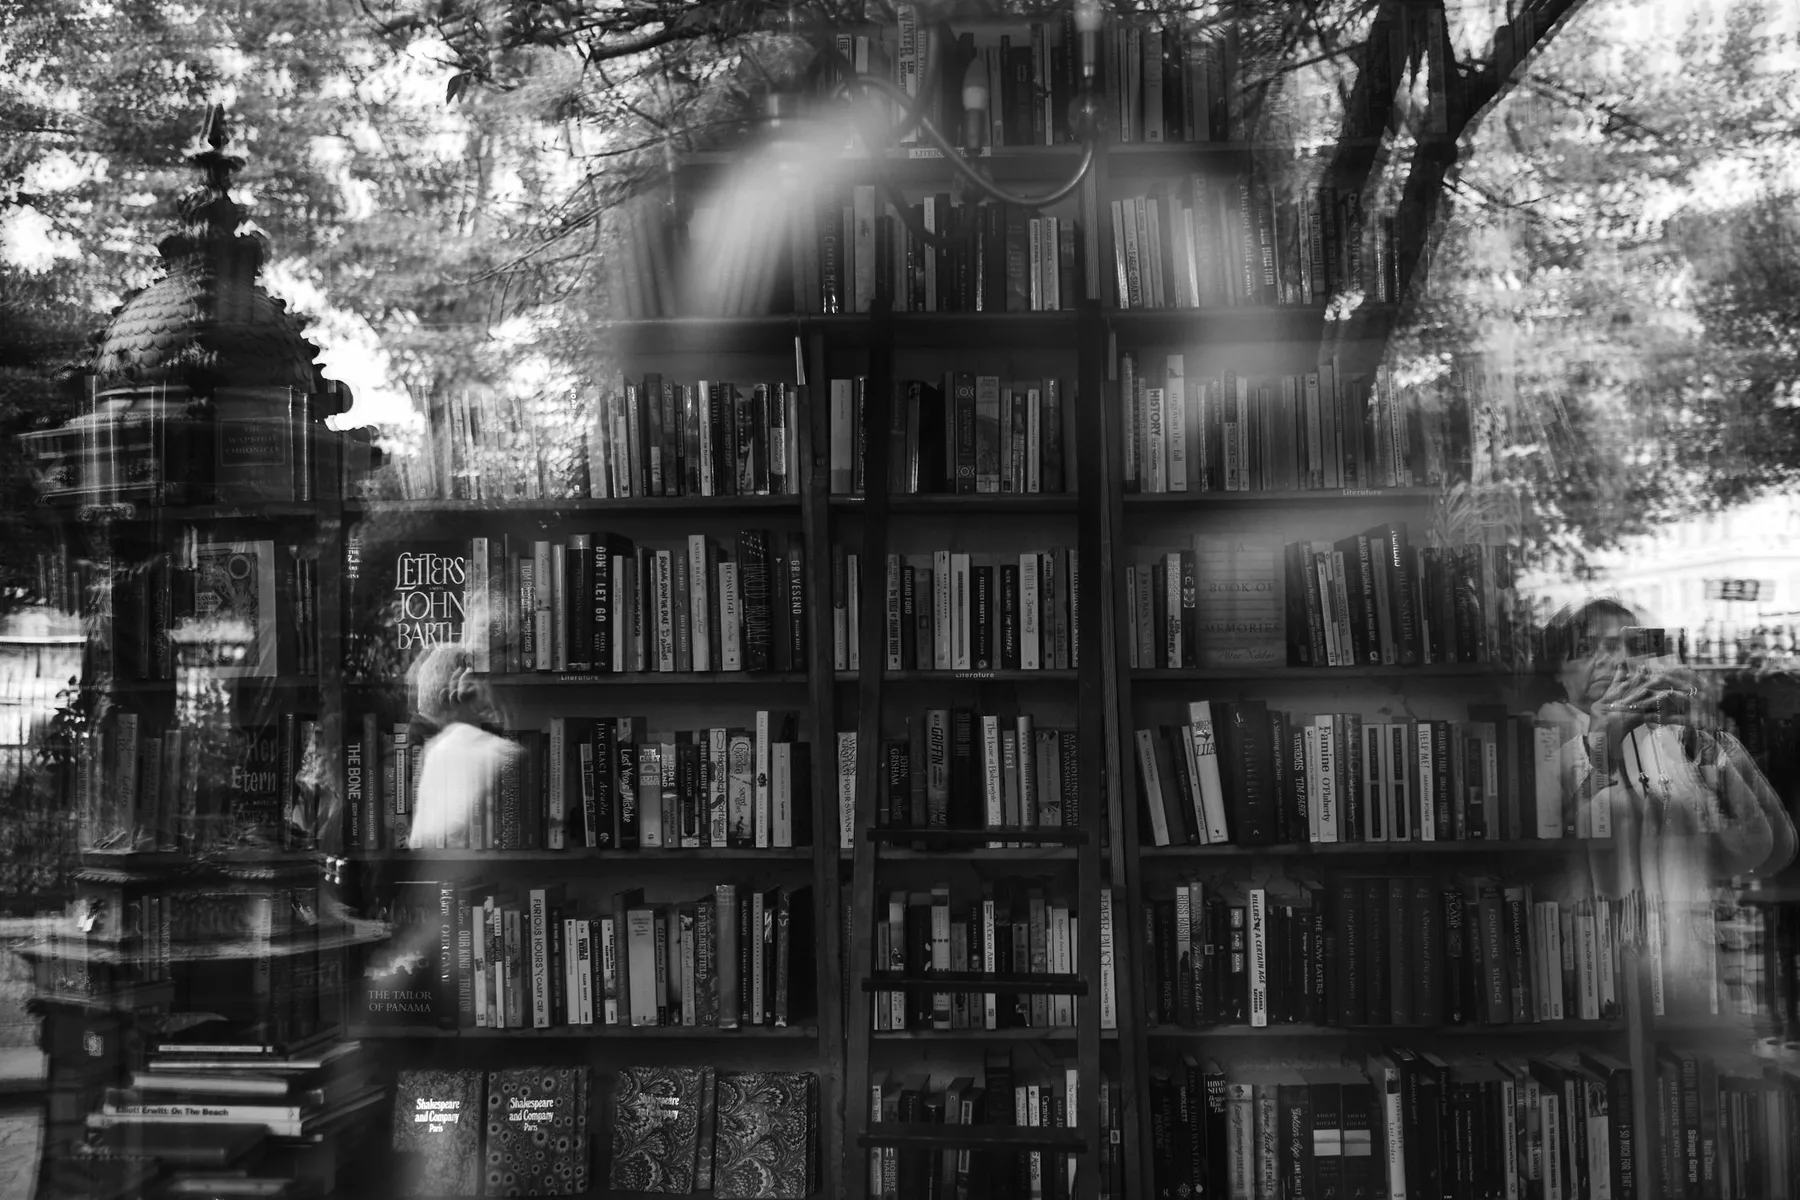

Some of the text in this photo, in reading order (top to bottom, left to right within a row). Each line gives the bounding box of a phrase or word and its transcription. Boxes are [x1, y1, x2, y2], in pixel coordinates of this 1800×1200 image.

[899, 11, 915, 58] WINTER
[907, 61, 915, 75] LEN
[1240, 190, 1254, 263] Margot Affair
[1129, 250, 1140, 303] LEAGUE SHARKS
[1149, 390, 1162, 437] HISTORY
[1172, 450, 1183, 462] fall
[1358, 536, 1368, 561] BARRY
[394, 552, 465, 590] LETTERS
[521, 565, 532, 579] TOM
[595, 546, 606, 622] DON'T LET GO
[659, 556, 669, 582] BRINGING
[1360, 562, 1371, 595] NORMAN
[790, 560, 802, 615] GRAVESEND
[904, 570, 912, 614] RICHARD FORD
[1209, 583, 1249, 592] BOOK
[394, 590, 466, 622] JOHN
[661, 611, 670, 625] DUKE
[1401, 600, 1412, 640] NAPIER
[397, 621, 466, 651] BARTH
[348, 742, 361, 766] THE
[931, 727, 944, 766] GRIFFIN
[1005, 738, 1015, 769] thirst
[1419, 730, 1429, 752] HELP
[596, 722, 608, 816] JIM Arcadia
[661, 754, 669, 788] ENGLAND
[668, 754, 676, 788] MIDDLE
[700, 740, 708, 789] DOUBLE NEGATIVE
[714, 751, 725, 792] Hopscotch
[840, 738, 849, 776] GRAHAM
[890, 748, 900, 786] GRISHAM
[900, 756, 908, 779] JOHN
[987, 722, 998, 804] The Bishopsgate
[1420, 753, 1430, 769] ME!
[348, 767, 361, 799] BONE
[619, 748, 635, 823] Last Year's Mistake
[1063, 752, 1072, 797] SPARSHOLT
[1294, 738, 1307, 818] EXTREMIS TIM PARKS
[1319, 725, 1332, 822] Famine O'Flaherty
[843, 778, 852, 833] FOUR SWANS
[1070, 760, 1079, 826] HOLLINGHURST
[1065, 800, 1073, 826] AFFAIR
[533, 899, 543, 936] FURIOUS
[1178, 895, 1190, 942] ROSS RAISIN
[1252, 894, 1261, 920] KILLERS
[1450, 902, 1458, 928] CAMP
[440, 924, 451, 950] OUR
[1100, 900, 1112, 969] PAPER PALACE
[1511, 901, 1522, 955] GRAHAM SWIFT
[534, 938, 544, 968] HOURS
[1255, 939, 1264, 969] CERTAIN
[1315, 915, 1324, 995] THE CROW EATERS
[1488, 908, 1503, 1005] FOUNTAINS SILENCE
[458, 930, 472, 1012] OUR KIND TRAITOR
[367, 990, 432, 1000] THE TAILOR
[368, 1002, 431, 1012] OF PANAMA
[536, 1001, 544, 1013] CEP
[1164, 981, 1172, 1010] RIVERS
[510, 1096, 554, 1111] Shakespeare
[1410, 1073, 1418, 1103] GRAHAM
[115, 1105, 229, 1116] Elliott Erwitt: On The Beach
[414, 1110, 460, 1125] and Company
[416, 1097, 460, 1112] Shakespeare
[508, 1109, 554, 1124] and Company
[1179, 1085, 1188, 1124] SMOLLETT
[1232, 1104, 1243, 1126] Early
[1263, 1099, 1273, 1129] Some
[428, 1123, 444, 1133] Paris
[524, 1122, 539, 1132] Paris
[1290, 1107, 1302, 1138] Golden
[1191, 1132, 1200, 1156] WENT
[1264, 1130, 1274, 1155] Luck
[1290, 1138, 1303, 1158] Age
[1687, 1129, 1700, 1184] Savage Gorge
[1619, 1129, 1633, 1188] SO MUCH FOR THAT
[1703, 1139, 1715, 1180] Main Chance
[883, 1159, 891, 1192] HARRIS
[1265, 1172, 1273, 1192] SMILEY
[1294, 1175, 1302, 1196] SMILEY
